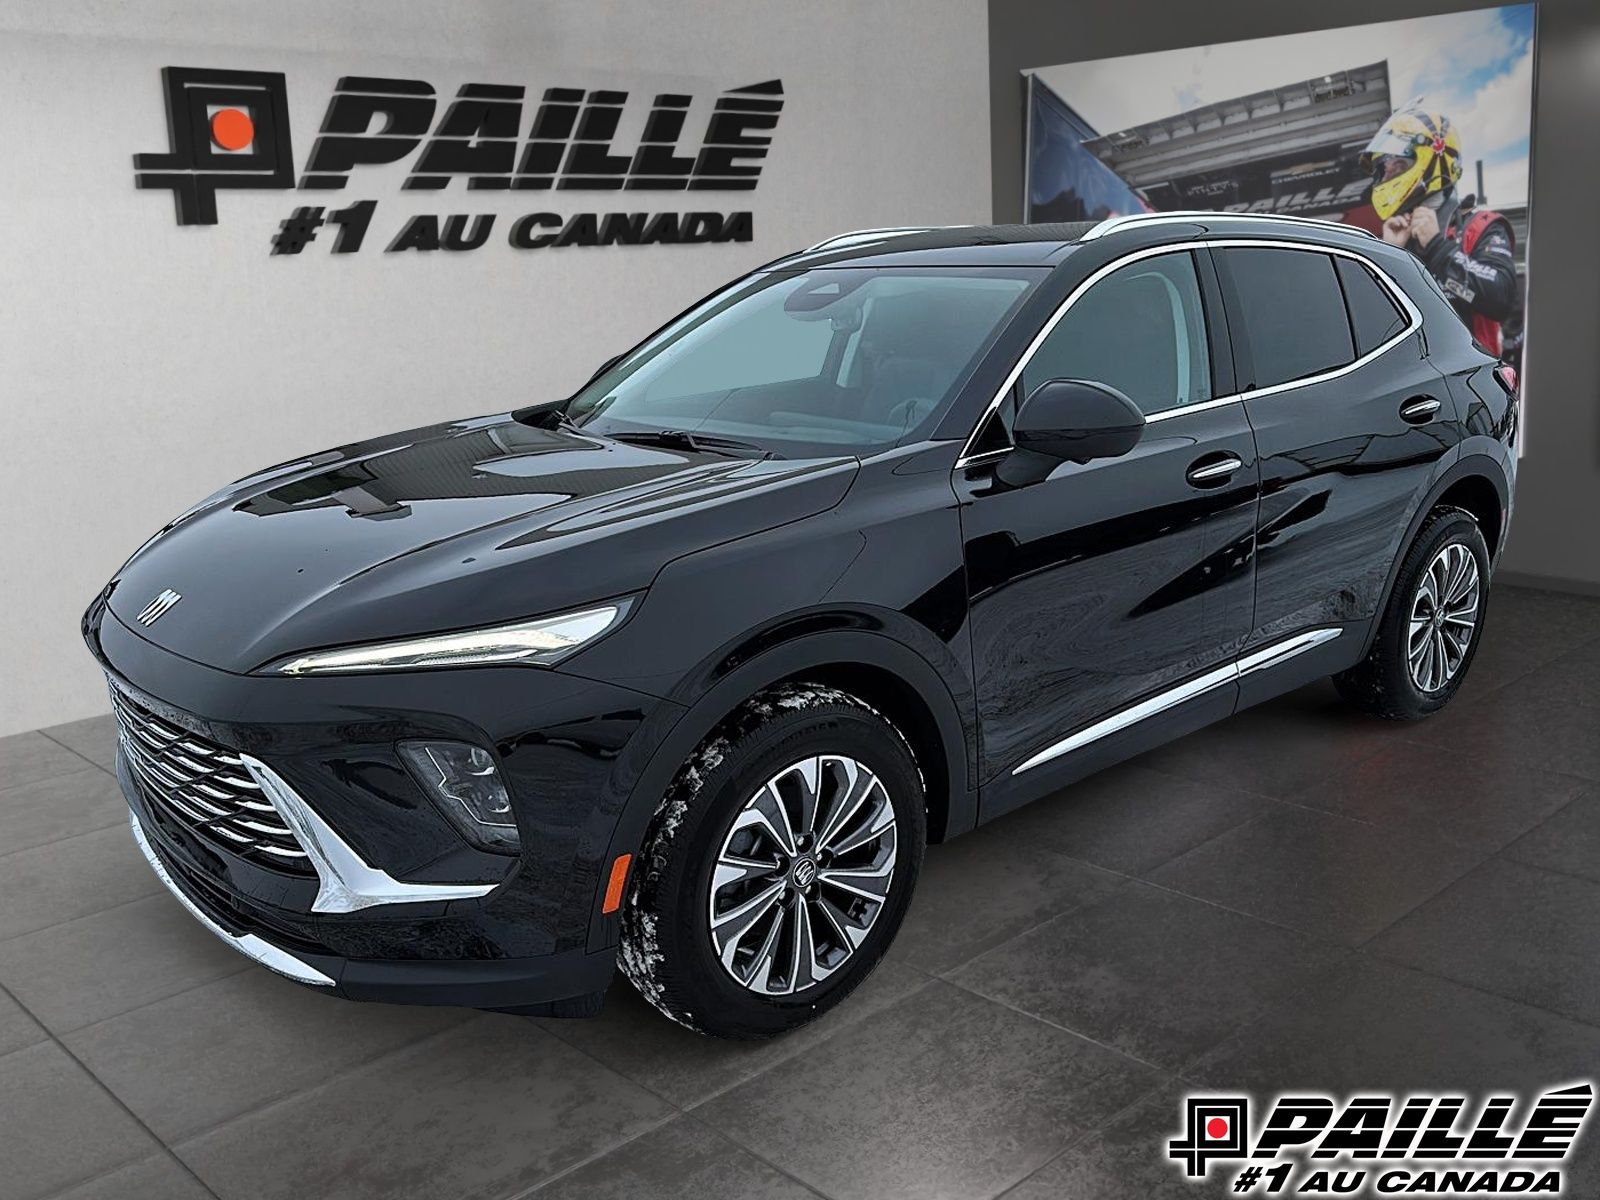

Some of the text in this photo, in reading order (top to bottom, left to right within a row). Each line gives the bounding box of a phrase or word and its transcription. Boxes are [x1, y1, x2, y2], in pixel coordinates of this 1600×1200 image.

[297, 77, 784, 190] PAILLÉ
[1271, 168, 1340, 184] CHEVROLET
[270, 200, 753, 256] #1 AU CANADA
